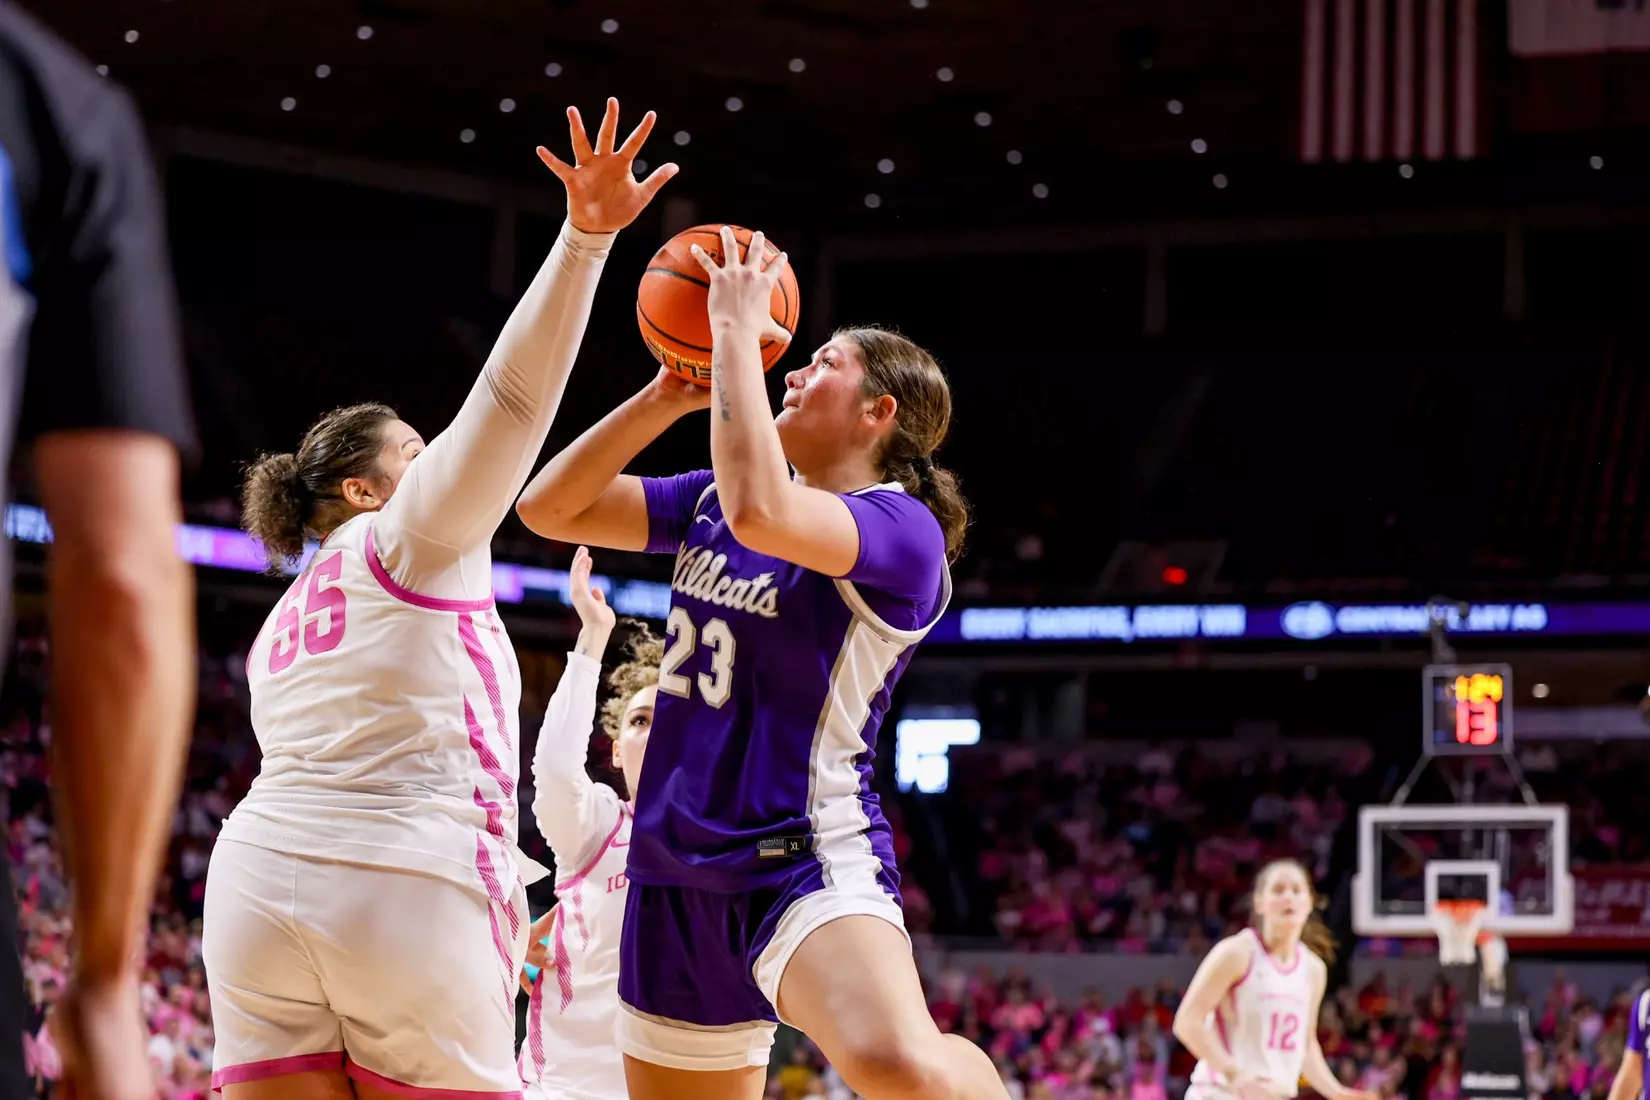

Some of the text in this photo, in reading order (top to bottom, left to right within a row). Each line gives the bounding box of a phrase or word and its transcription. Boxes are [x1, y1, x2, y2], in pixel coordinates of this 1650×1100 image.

[268, 550, 347, 674] 55
[657, 605, 736, 709] 23
[1456, 698, 1497, 745] 13
[790, 841, 800, 851] XL
[606, 871, 627, 893] IO
[1267, 1011, 1300, 1051] 12
